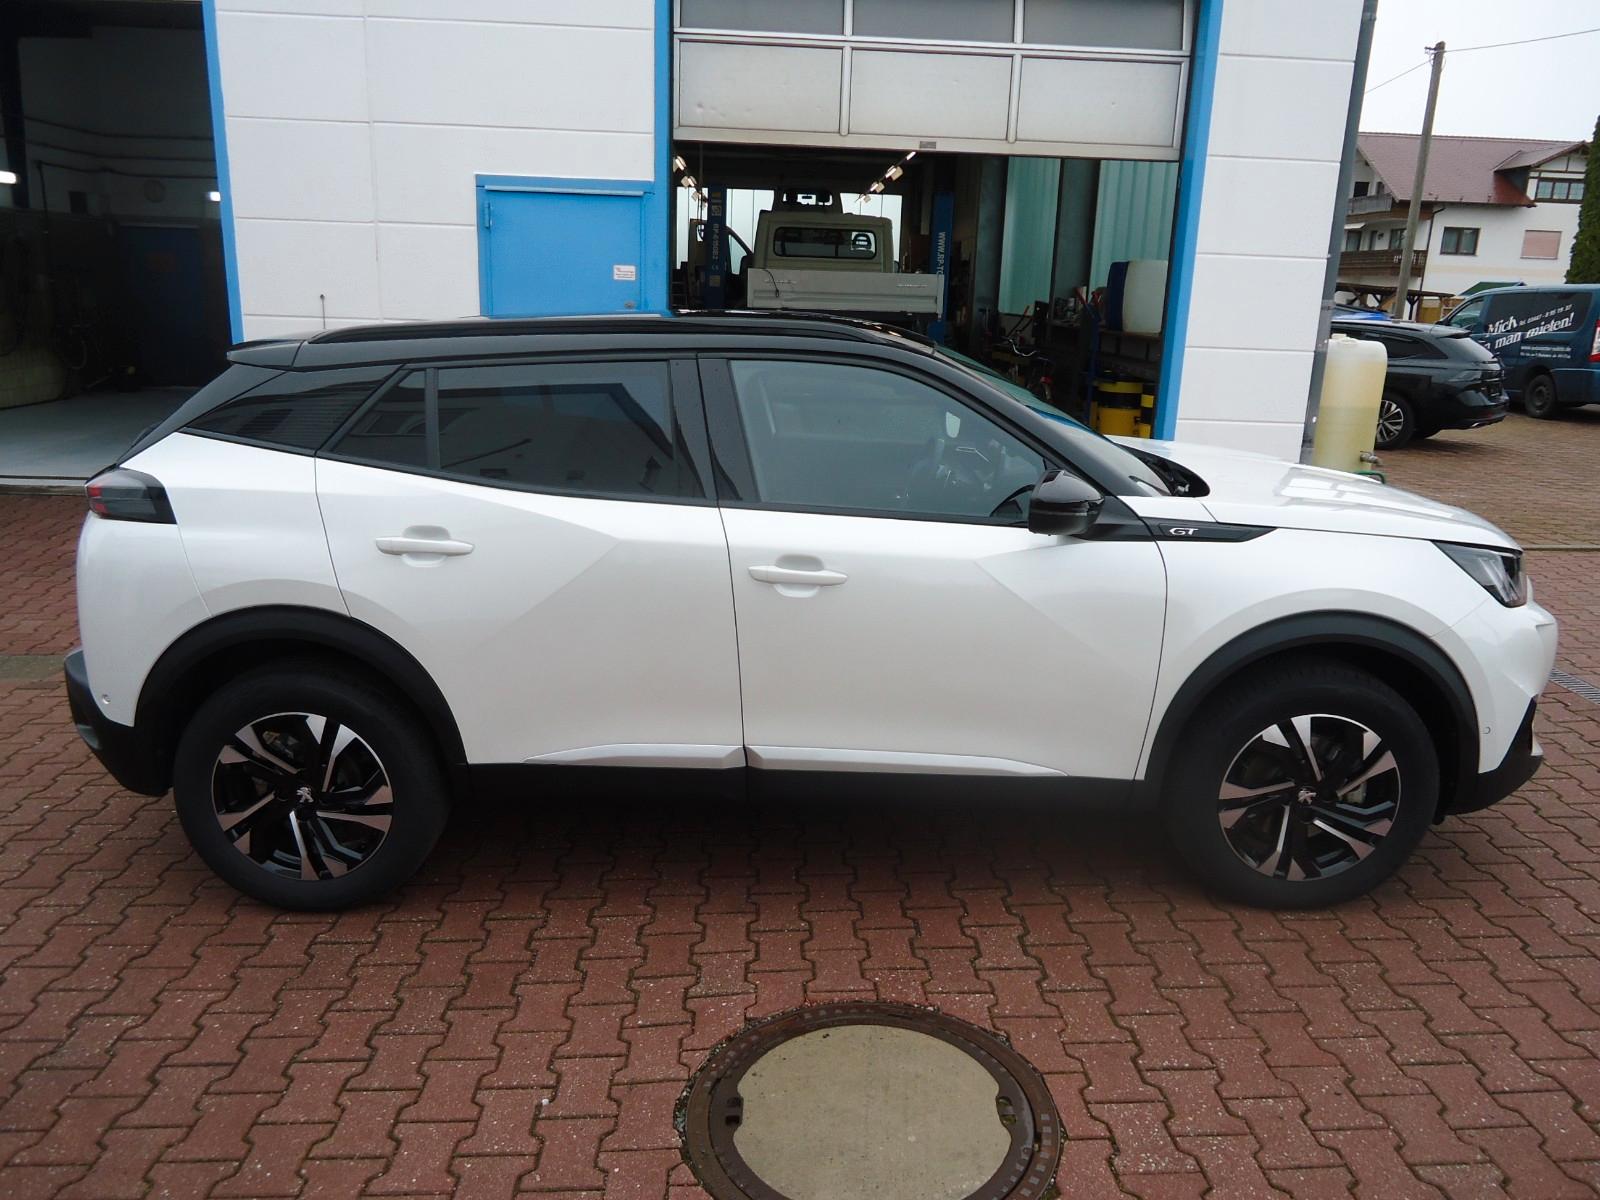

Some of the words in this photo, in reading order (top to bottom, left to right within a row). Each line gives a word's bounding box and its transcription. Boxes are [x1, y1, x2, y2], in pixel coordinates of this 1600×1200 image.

[1485, 316, 1517, 336] Mich
[1495, 332, 1521, 348] man
[1526, 312, 1574, 338] mieten!
[1169, 527, 1199, 536] GT
